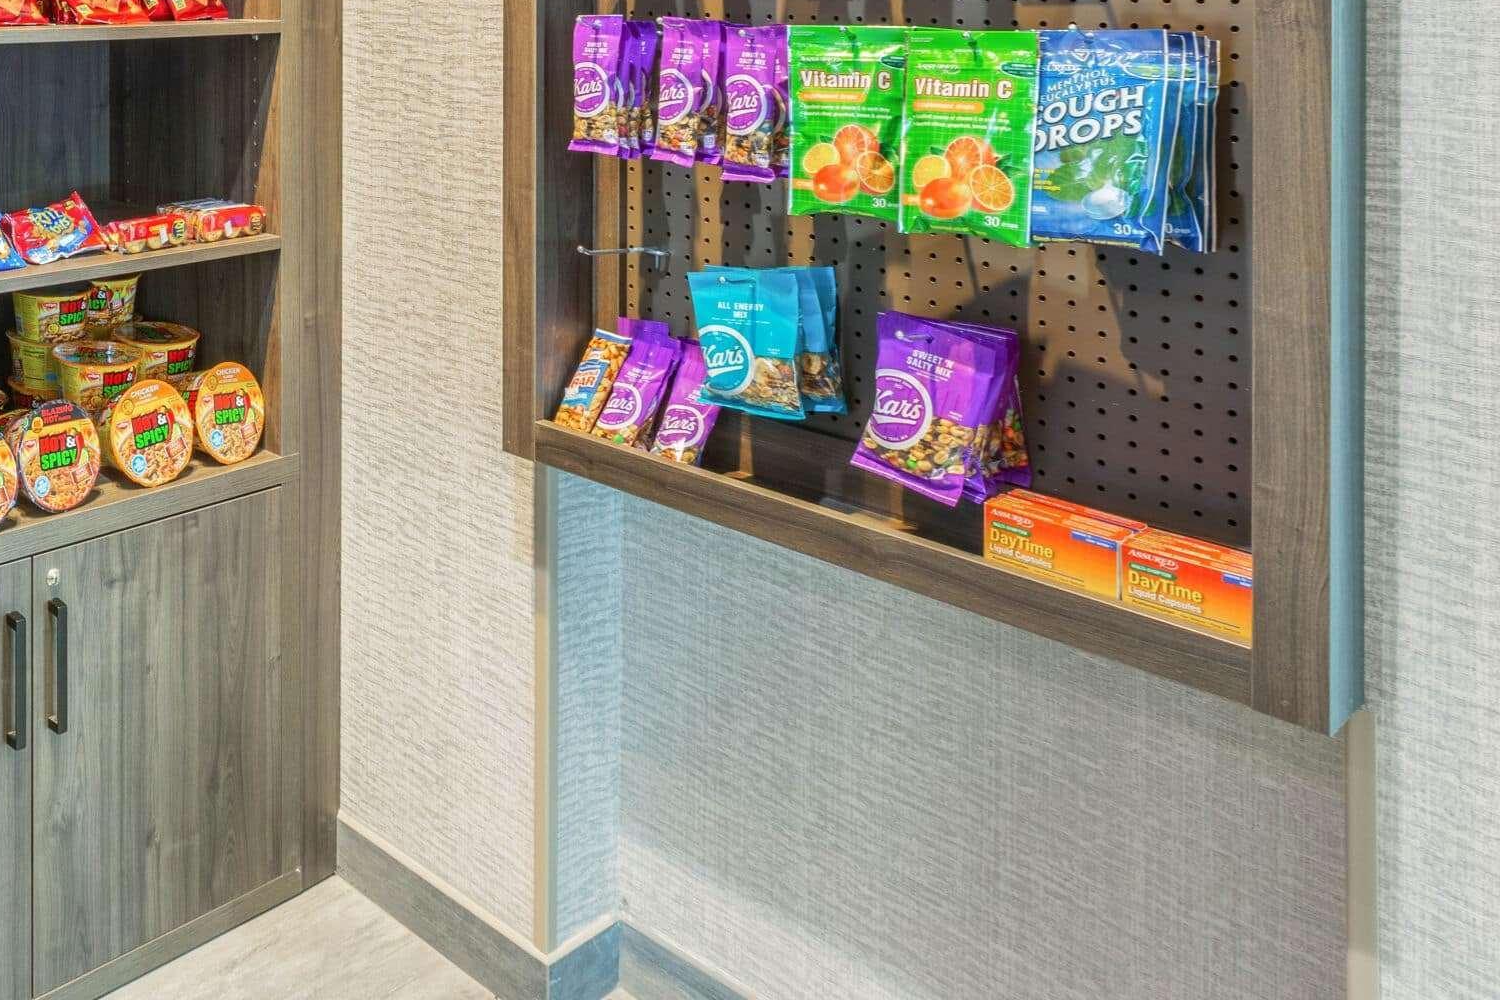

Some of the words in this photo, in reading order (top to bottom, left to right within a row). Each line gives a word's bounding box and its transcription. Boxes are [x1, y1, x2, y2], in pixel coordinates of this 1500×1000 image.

[573, 77, 602, 94] Kar's
[799, 69, 872, 89] Vitamin
[876, 70, 892, 90] C
[915, 78, 990, 98] Vitamin
[996, 80, 1013, 99] C
[1048, 69, 1109, 93] MENTHOL
[1036, 85, 1146, 124] OUGH
[872, 198, 887, 209] 30
[984, 215, 1001, 227] 30
[1113, 223, 1132, 235] 30
[59, 299, 82, 313] HOT
[717, 302, 731, 310] ALL
[733, 302, 764, 311] ENERGY
[58, 311, 86, 326] SPICY
[168, 348, 189, 363] HOT
[703, 345, 745, 368] Kar's
[912, 350, 943, 365] SWEET
[167, 360, 193, 375] SPICY
[906, 356, 933, 371] SALTY
[934, 365, 953, 377] MIX
[103, 371, 127, 385] HOT
[573, 375, 596, 386] BAR
[213, 392, 236, 411] HOT
[235, 394, 244, 406] &
[874, 389, 923, 418] Kar's
[132, 411, 158, 434] HOT
[157, 412, 167, 425] &
[215, 407, 245, 425] SPICY
[662, 415, 695, 431] Kar's
[39, 434, 67, 454] HOT
[66, 435, 76, 447] &
[135, 425, 168, 449] SPICY
[41, 448, 77, 471] SPICY
[989, 528, 1054, 558] DayTime
[989, 542, 1014, 556] Liquid
[1128, 570, 1203, 603] DayTime
[1128, 585, 1157, 601] Liquid
[1157, 595, 1202, 614] Capsules
